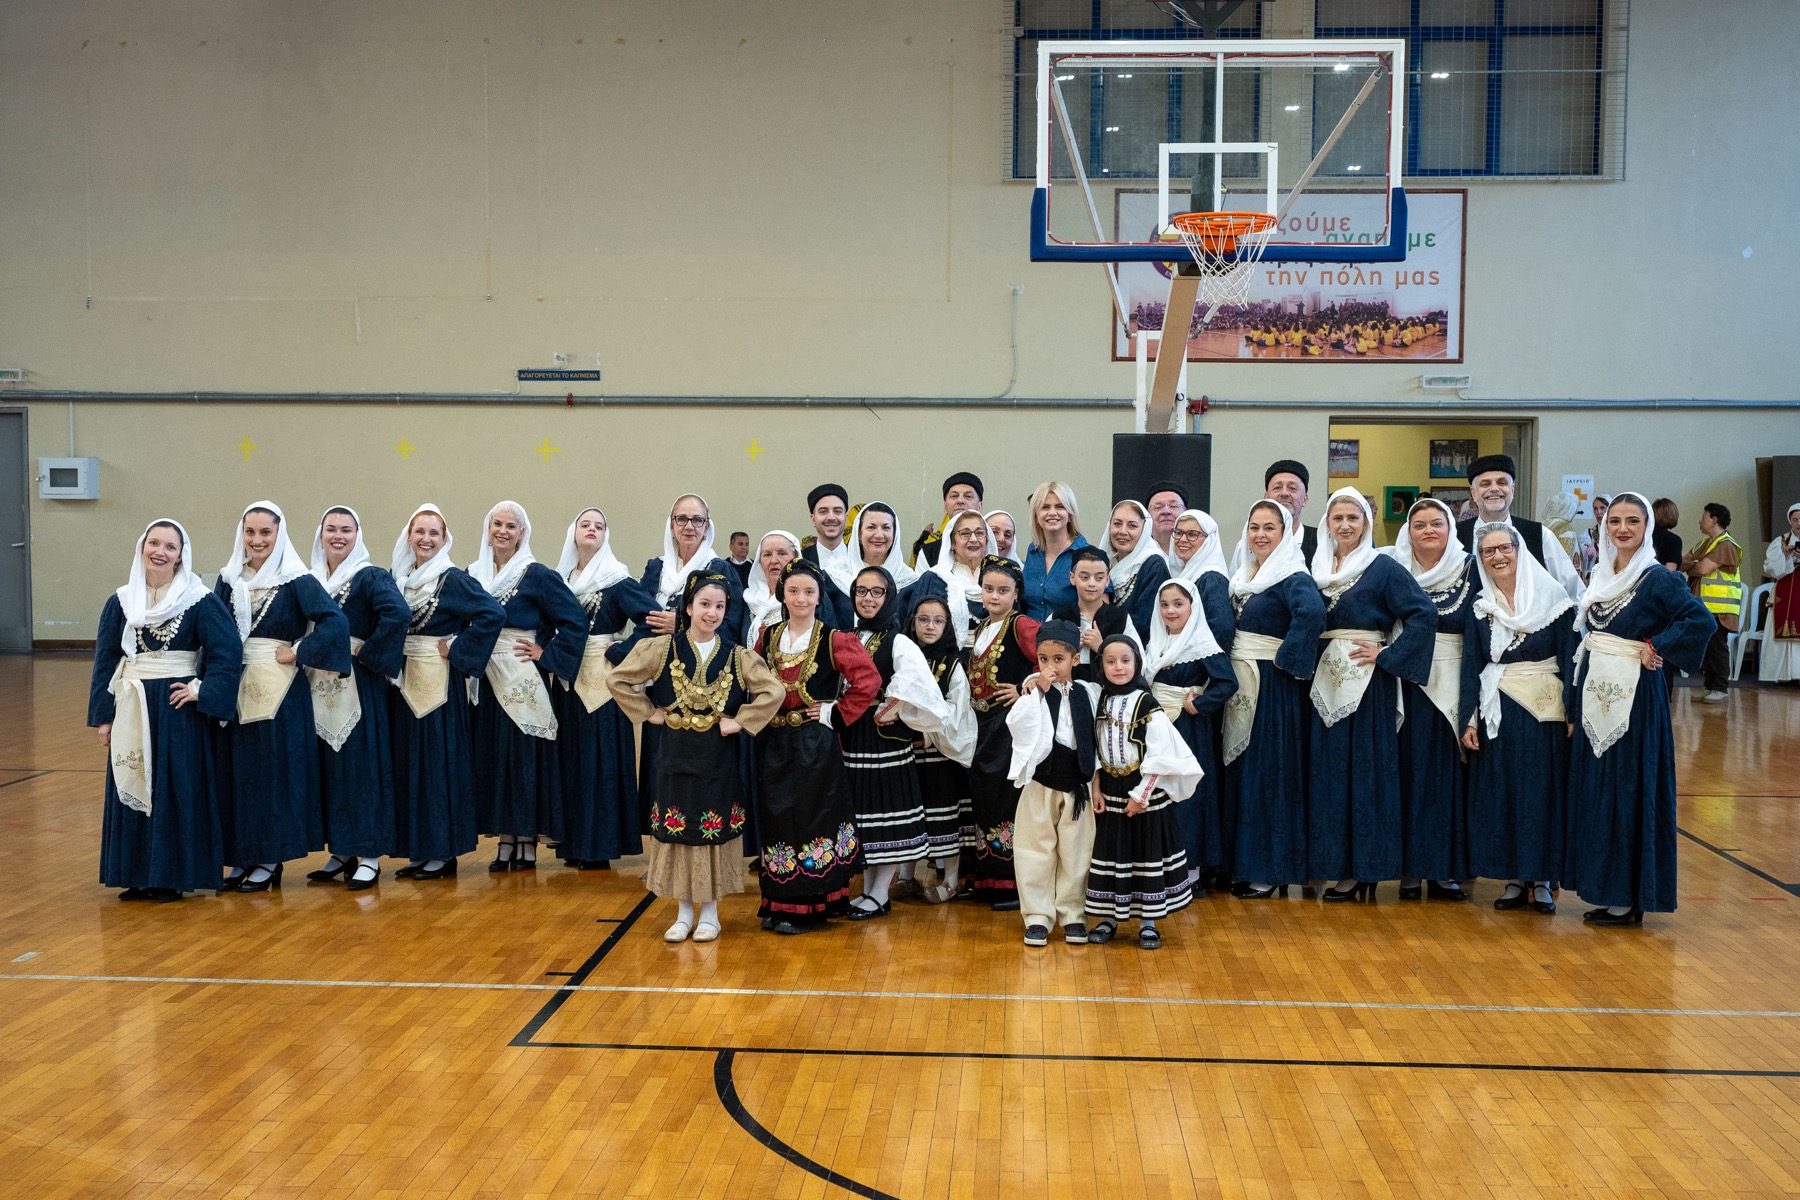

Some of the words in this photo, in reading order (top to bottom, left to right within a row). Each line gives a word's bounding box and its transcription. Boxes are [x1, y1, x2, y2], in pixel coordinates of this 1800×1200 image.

[1266, 270, 1307, 285] την
[1320, 265, 1382, 286] πόλη
[1395, 270, 1440, 290] μας
